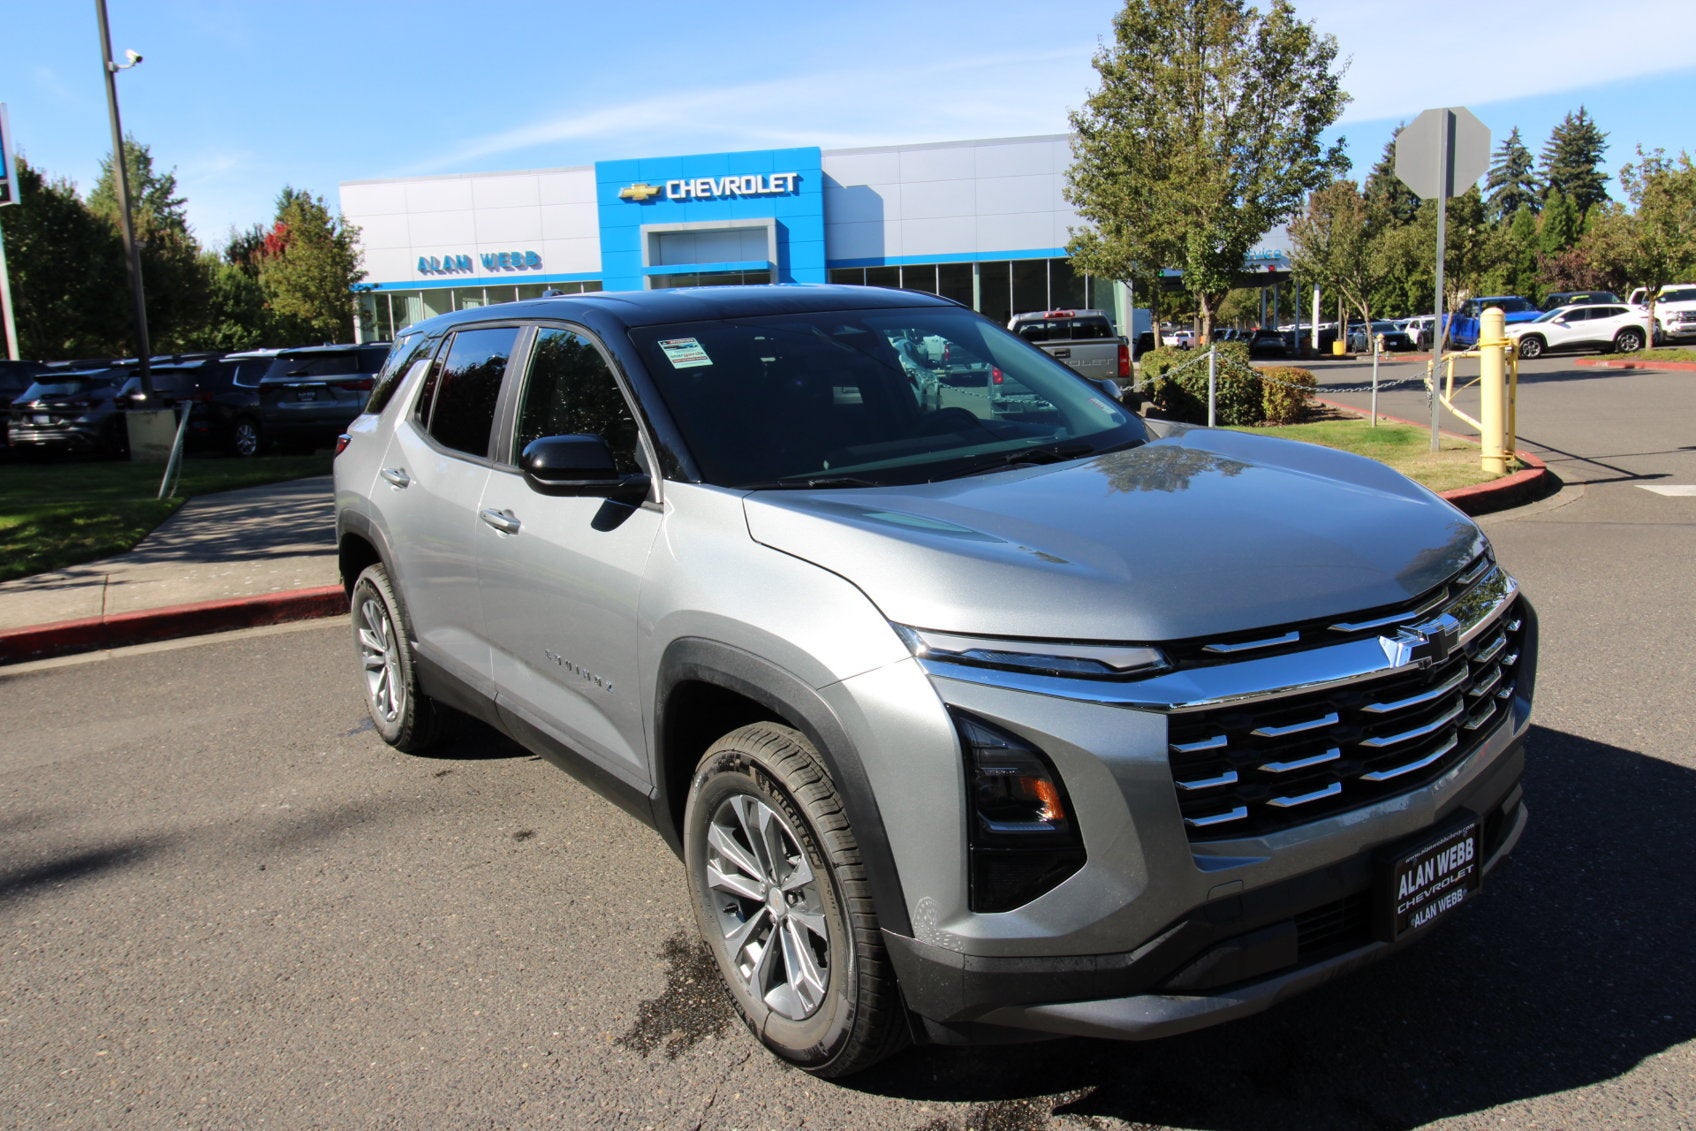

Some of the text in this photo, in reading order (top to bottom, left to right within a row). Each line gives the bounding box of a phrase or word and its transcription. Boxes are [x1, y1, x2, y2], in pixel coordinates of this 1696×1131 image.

[666, 172, 798, 199] CHEVROLET
[417, 251, 543, 275] ALAN WEBB
[1398, 837, 1474, 900] ALAN WEBB
[1397, 864, 1474, 914] CHEVROLET
[1414, 888, 1463, 928] ALAN WEBB
